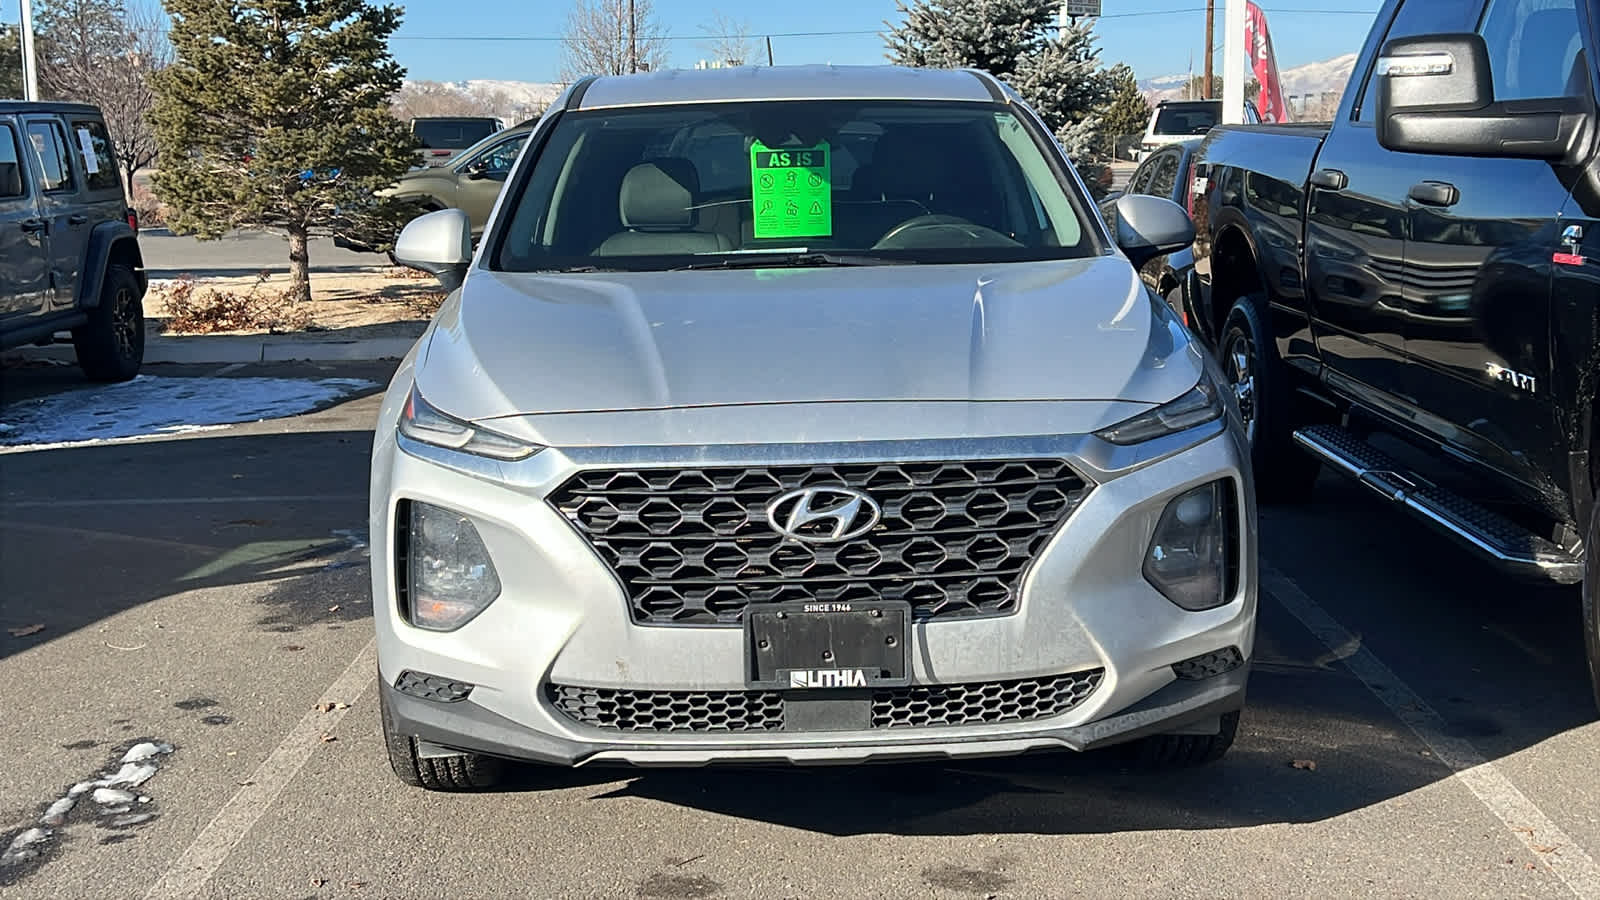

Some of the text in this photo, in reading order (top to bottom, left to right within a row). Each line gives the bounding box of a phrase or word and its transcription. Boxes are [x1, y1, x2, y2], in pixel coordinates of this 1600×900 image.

[769, 152, 812, 167] AS IS
[803, 603, 852, 613] SINCE 1946
[807, 669, 867, 688] LITHIA
